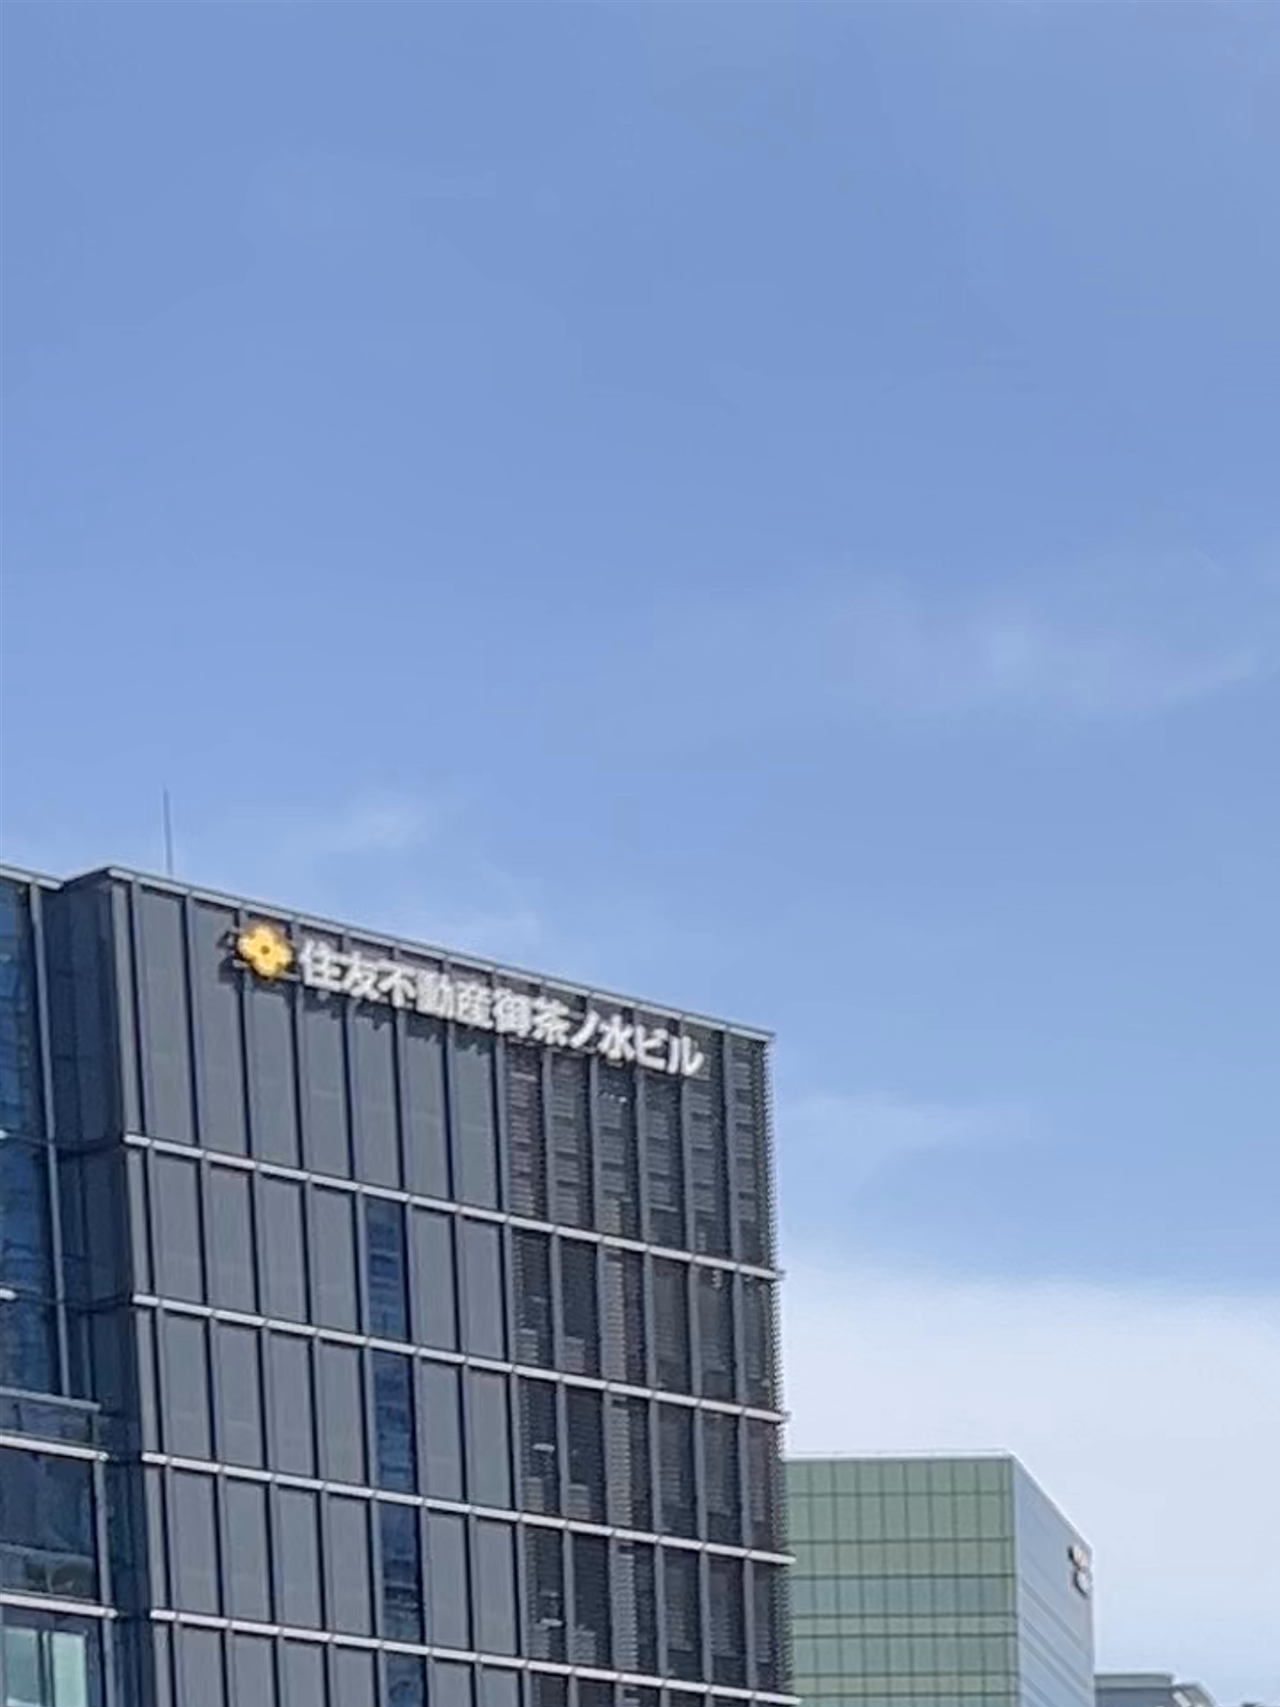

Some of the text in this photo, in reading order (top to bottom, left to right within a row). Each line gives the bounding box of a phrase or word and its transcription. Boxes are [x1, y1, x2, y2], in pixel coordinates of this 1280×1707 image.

[301, 938, 704, 1077] 住友不動産御茶ノ水ビル
